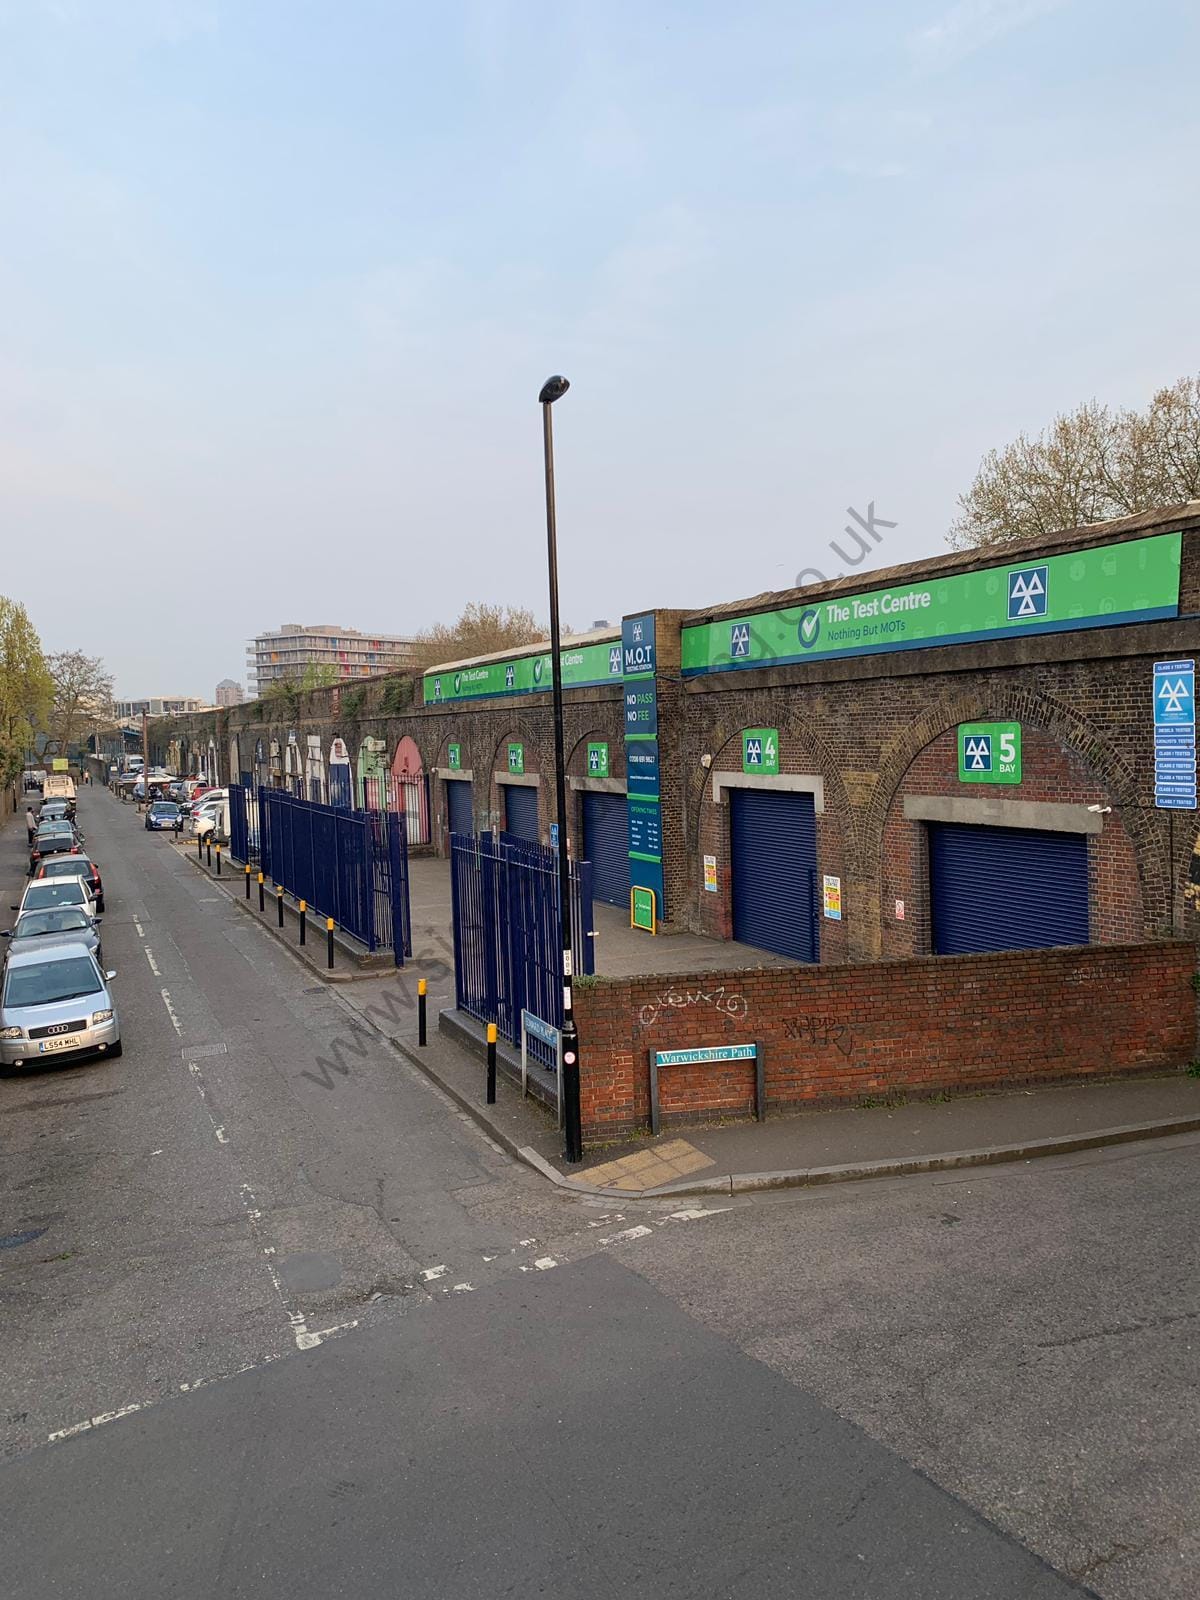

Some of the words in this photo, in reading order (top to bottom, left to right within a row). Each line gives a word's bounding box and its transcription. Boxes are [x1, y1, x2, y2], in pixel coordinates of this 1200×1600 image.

[826, 604, 850, 624] The
[852, 599, 879, 619] Test
[881, 591, 931, 614] Centre
[827, 627, 861, 641] Nothing
[863, 625, 878, 636] But
[880, 620, 906, 633] MOTs
[565, 654, 583, 665] Centre
[625, 645, 652, 666] M.O.T
[626, 694, 637, 705] NO
[637, 693, 653, 704] PASS
[627, 711, 637, 722] NO
[637, 710, 649, 721] FEE
[765, 736, 776, 759] 4
[1000, 733, 1016, 763] 5
[517, 749, 523, 763] 2
[600, 748, 607, 766] 3
[1000, 764, 1016, 773] BAY
[44, 1041, 63, 1050] LS54
[64, 1037, 78, 1046] MHL
[660, 1050, 728, 1063] Warwickshire
[731, 1047, 753, 1057] Path
